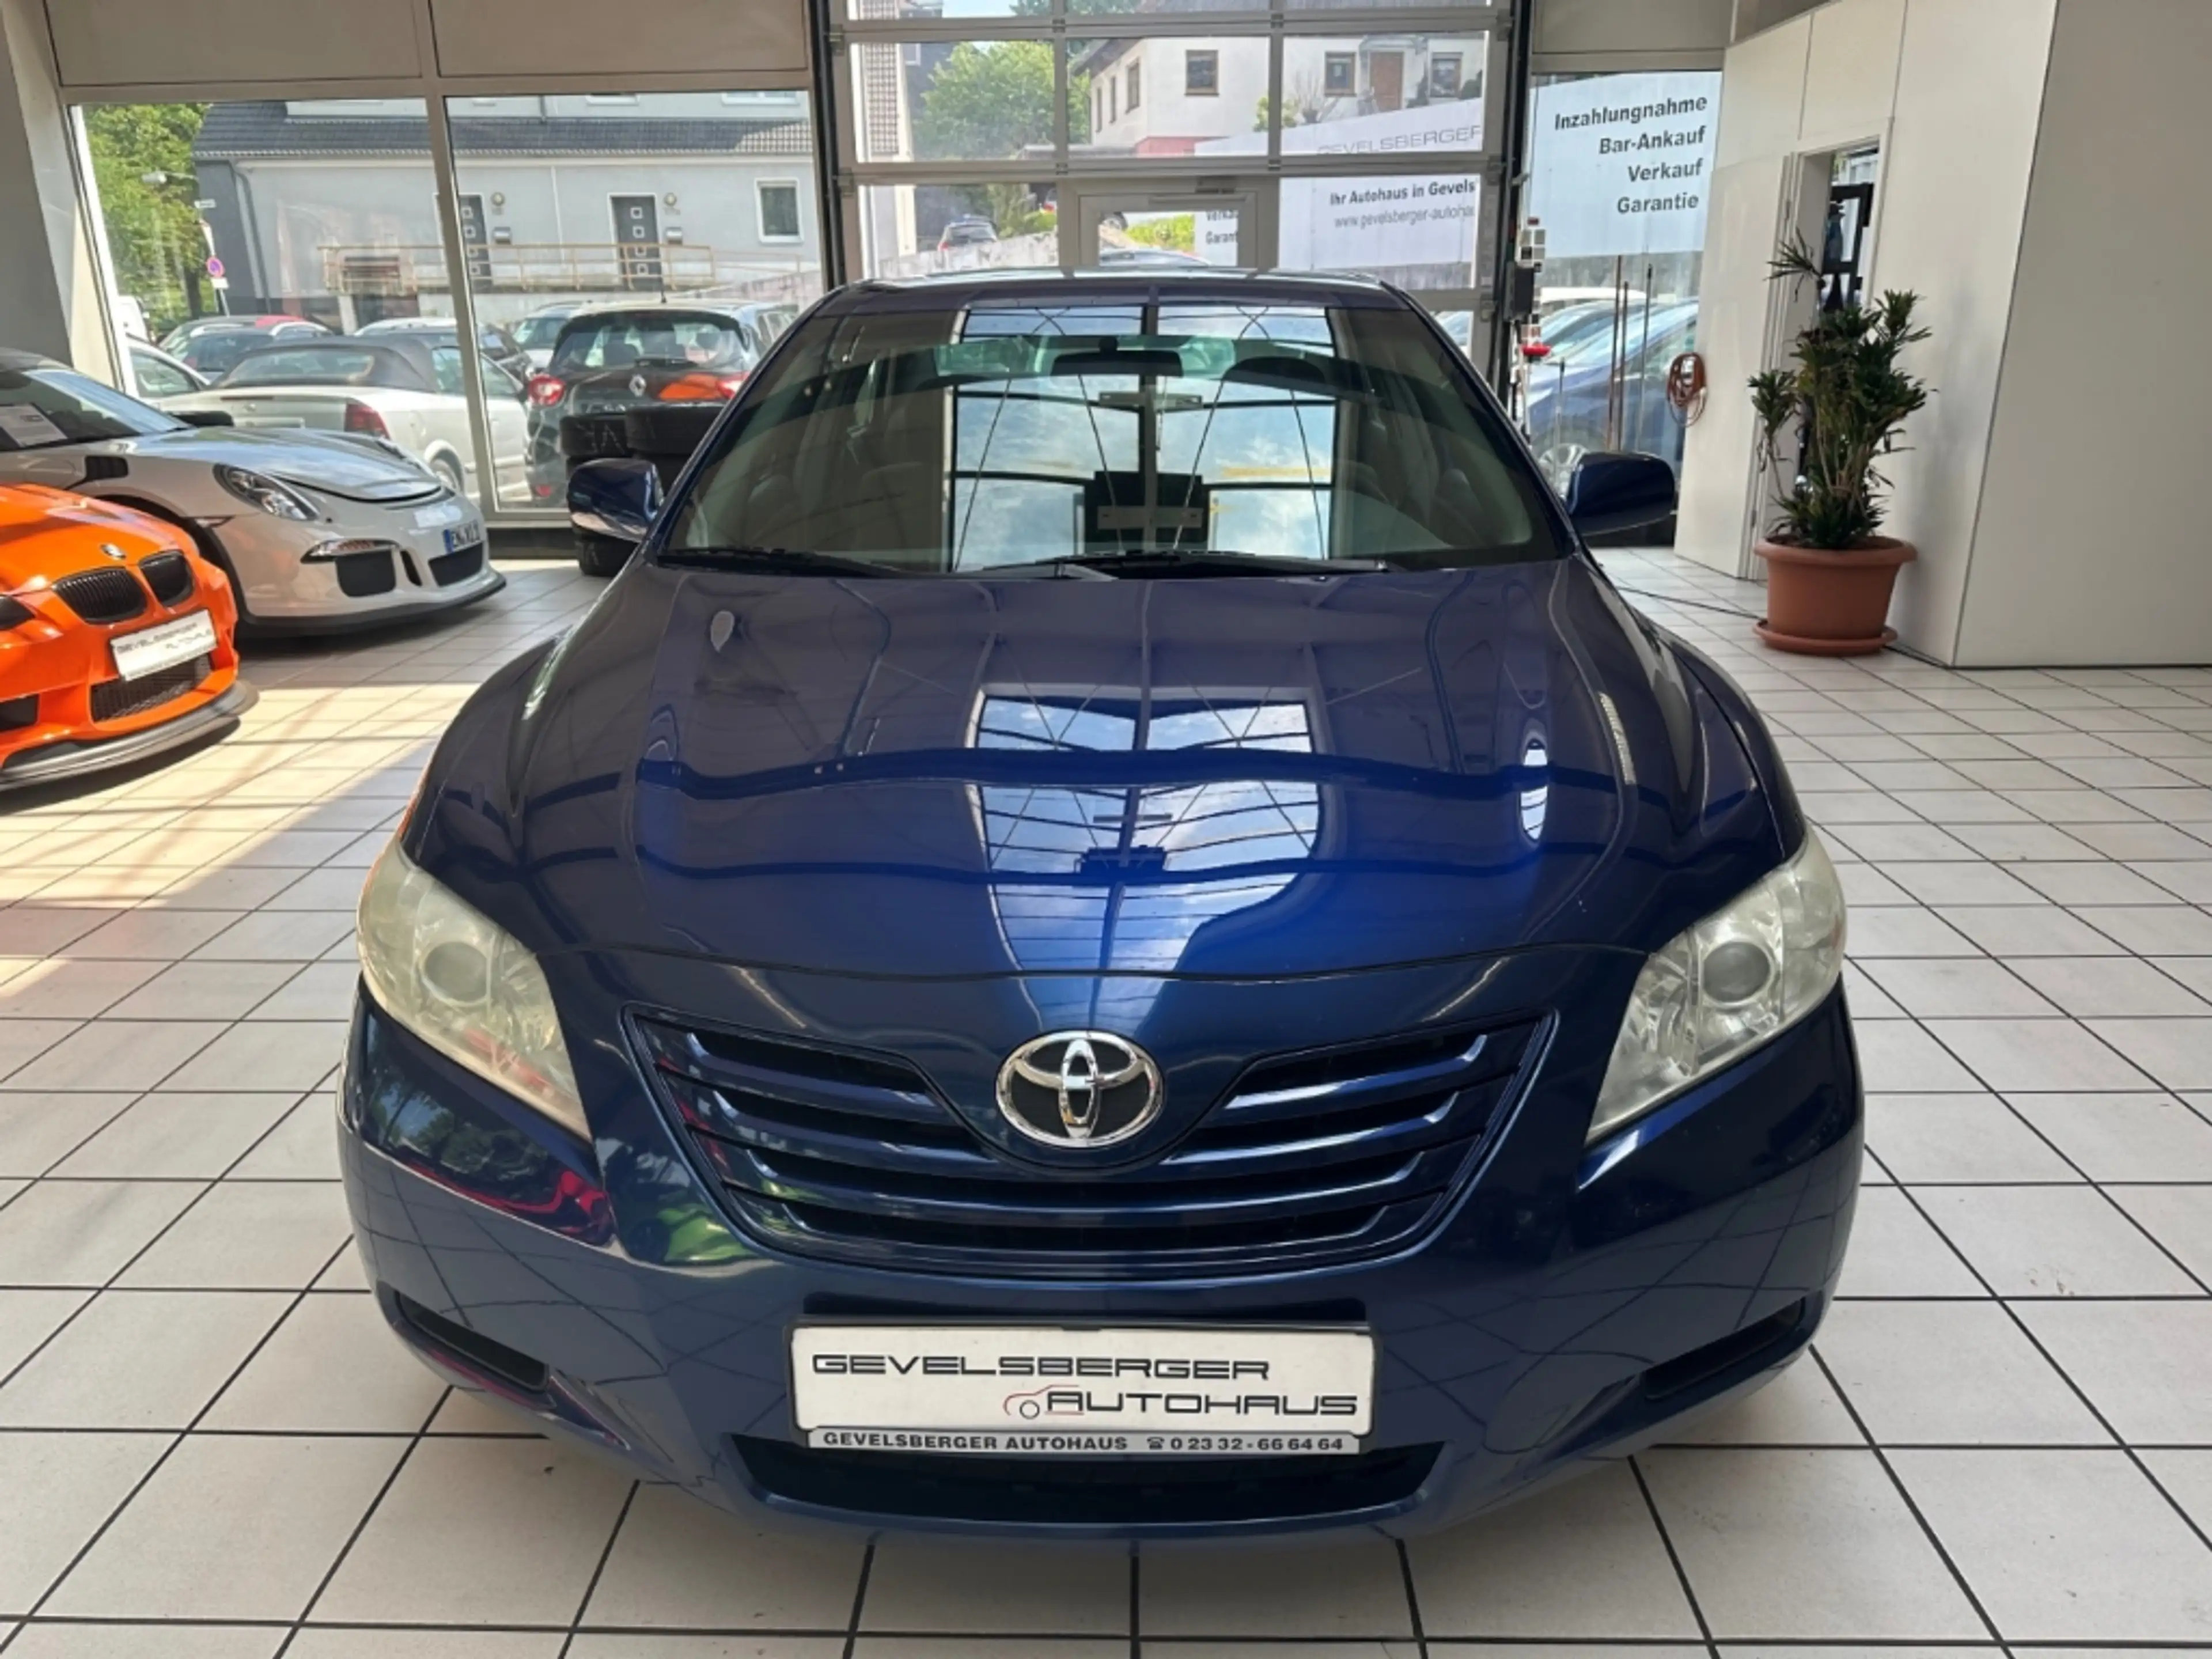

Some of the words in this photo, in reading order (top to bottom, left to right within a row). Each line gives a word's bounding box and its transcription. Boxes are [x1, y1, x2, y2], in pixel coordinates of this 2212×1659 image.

[1555, 96, 1708, 131] Inzahlungnahme
[1599, 126, 1707, 155] Bar-Ankauf
[1628, 158, 1703, 182] Verkauf
[1330, 192, 1346, 205] Ihr
[1349, 187, 1408, 204] Autohaus
[1412, 184, 1425, 197] in
[1617, 192, 1699, 214] Garantie
[812, 1354, 1269, 1380] GEVELSBERGER
[1047, 1391, 1357, 1415] AUTOHAUS
[823, 1431, 998, 1449] GEVELSBERGER
[1006, 1437, 1127, 1450] AUTOHAUS
